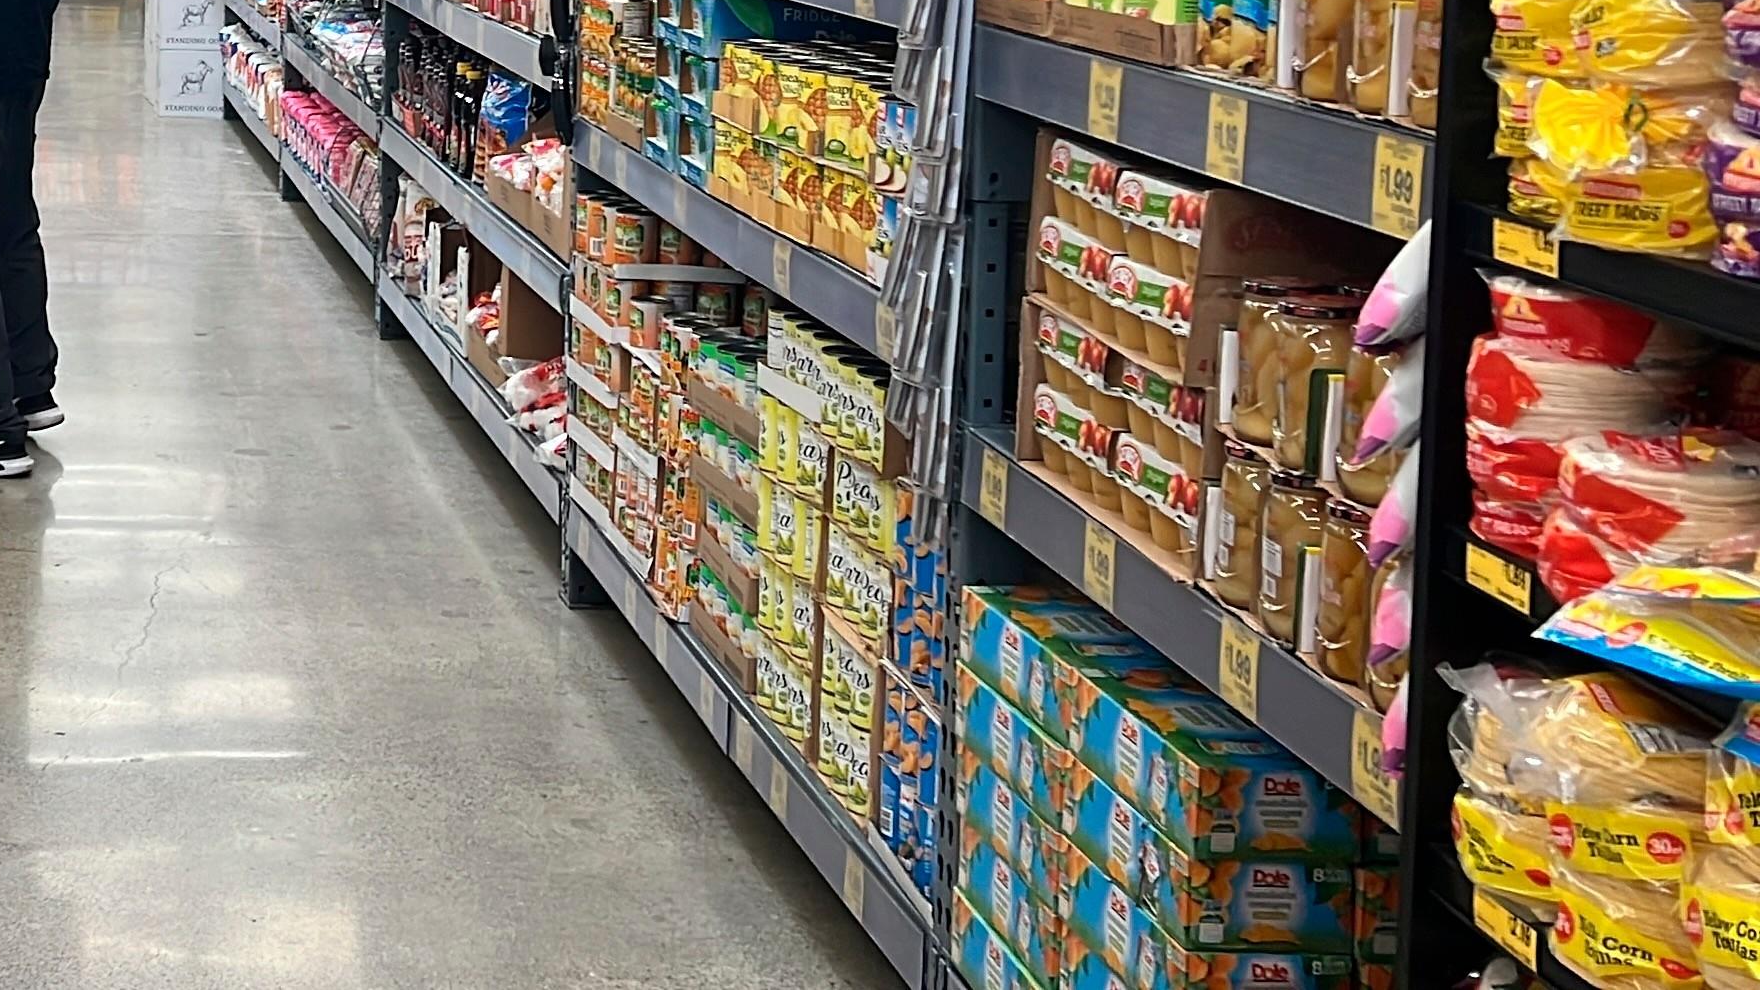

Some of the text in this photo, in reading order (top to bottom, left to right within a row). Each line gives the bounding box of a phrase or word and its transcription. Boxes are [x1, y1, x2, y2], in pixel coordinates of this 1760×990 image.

[1264, 777, 1301, 796] Dole
[1253, 869, 1290, 887] Dole
[1313, 867, 1324, 882] 8
[1602, 937, 1653, 962] Corn
[1252, 962, 1289, 982] Dole
[1311, 961, 1322, 976] 8
